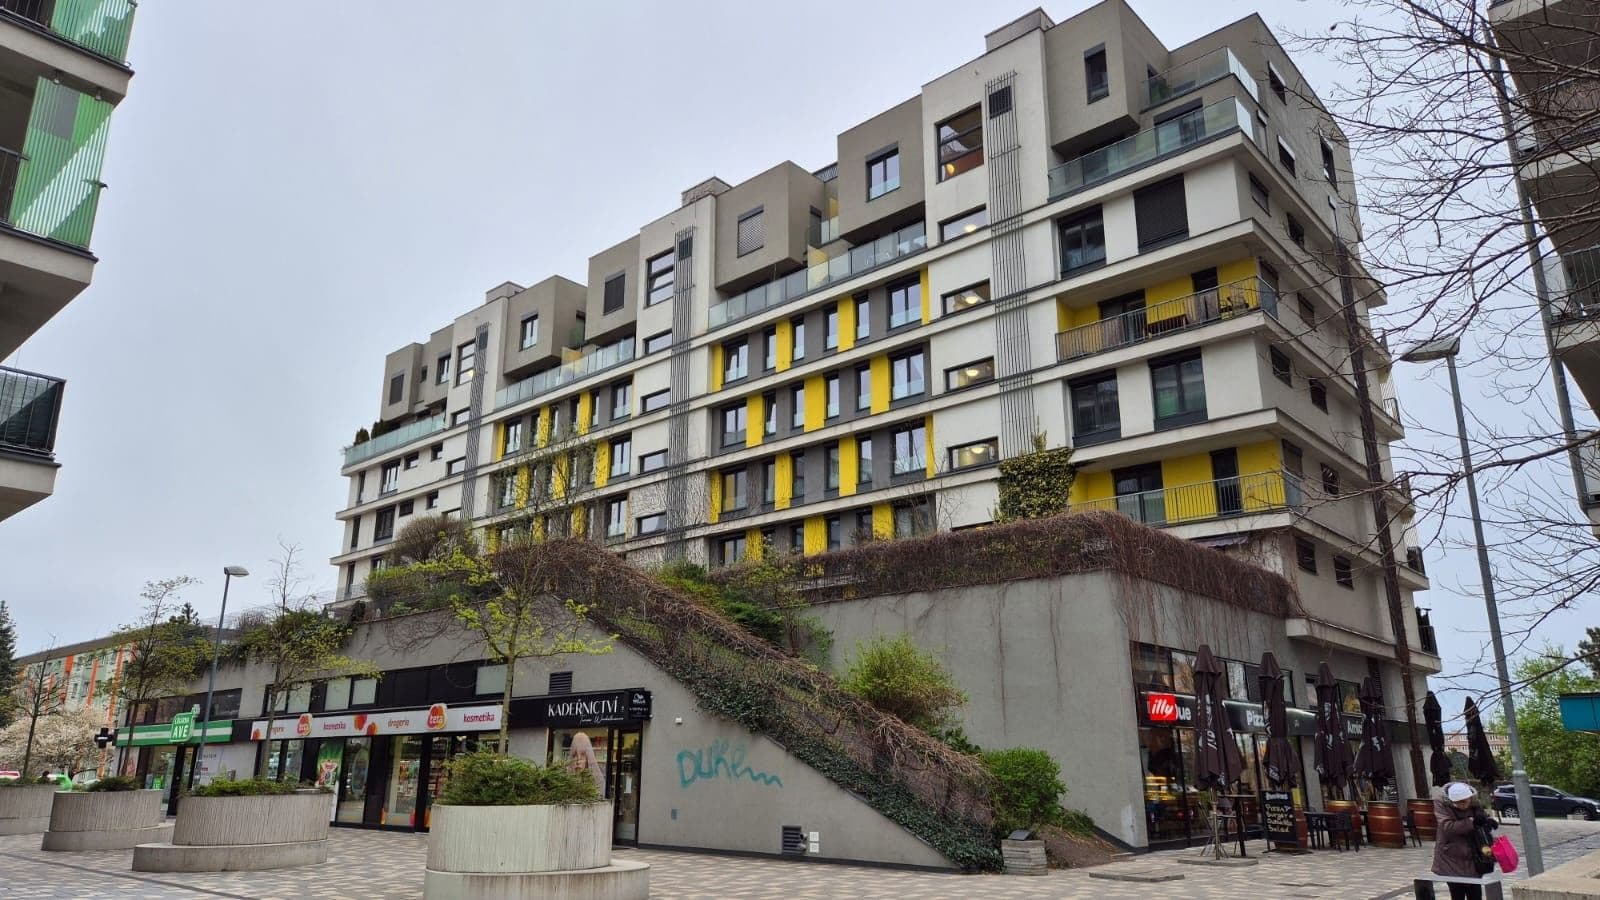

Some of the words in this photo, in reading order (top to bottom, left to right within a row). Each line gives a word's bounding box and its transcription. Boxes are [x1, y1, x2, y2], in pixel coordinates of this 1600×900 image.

[548, 696, 618, 717] KADEŘNICTVÍ
[1151, 698, 1174, 718] illy
[463, 712, 495, 723] kosmetika
[172, 725, 189, 739] AVE
